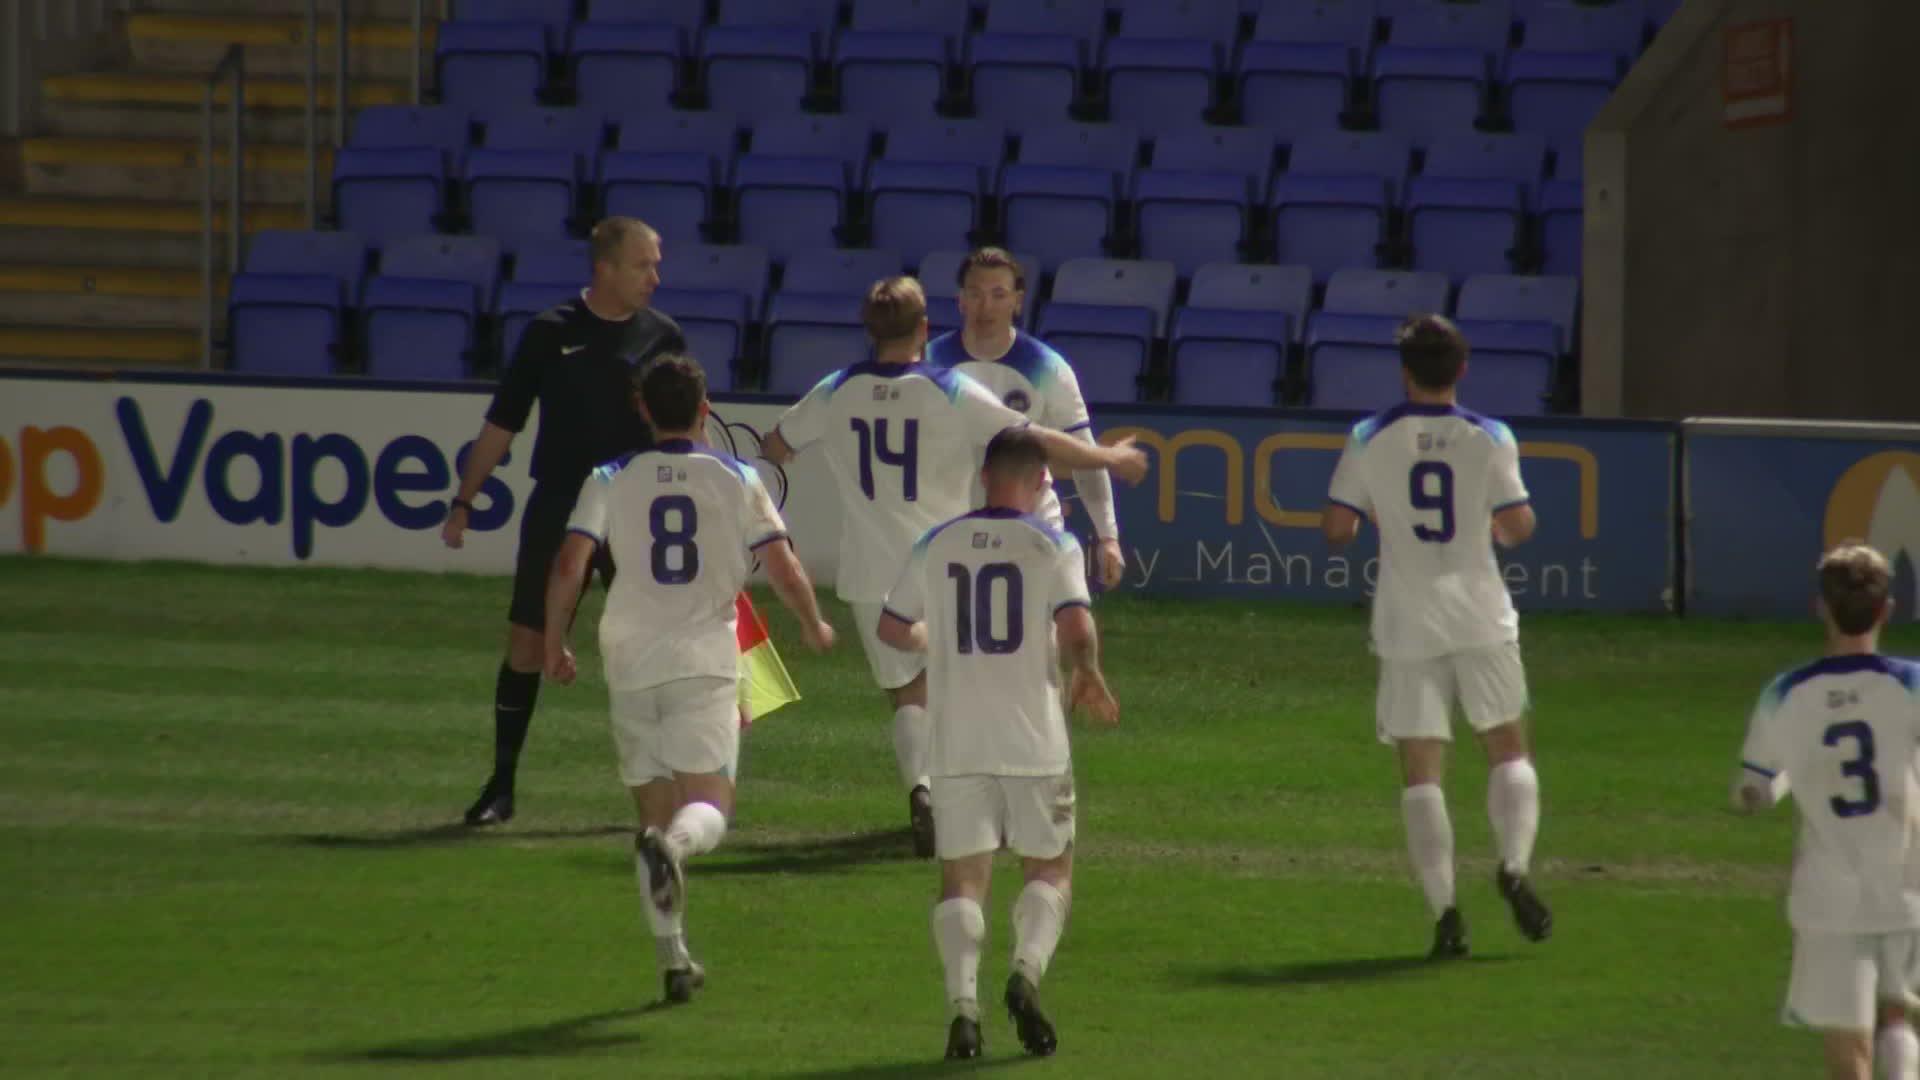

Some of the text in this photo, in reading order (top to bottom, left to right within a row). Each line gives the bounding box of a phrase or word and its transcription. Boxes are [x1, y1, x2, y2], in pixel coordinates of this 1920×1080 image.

[0, 396, 514, 560] p Vapes
[850, 416, 919, 502] 14
[1409, 460, 1456, 543] 9
[649, 494, 699, 585] 8
[1196, 540, 1599, 599] Managent
[947, 562, 1024, 655] 10
[1823, 720, 1880, 819] 3
